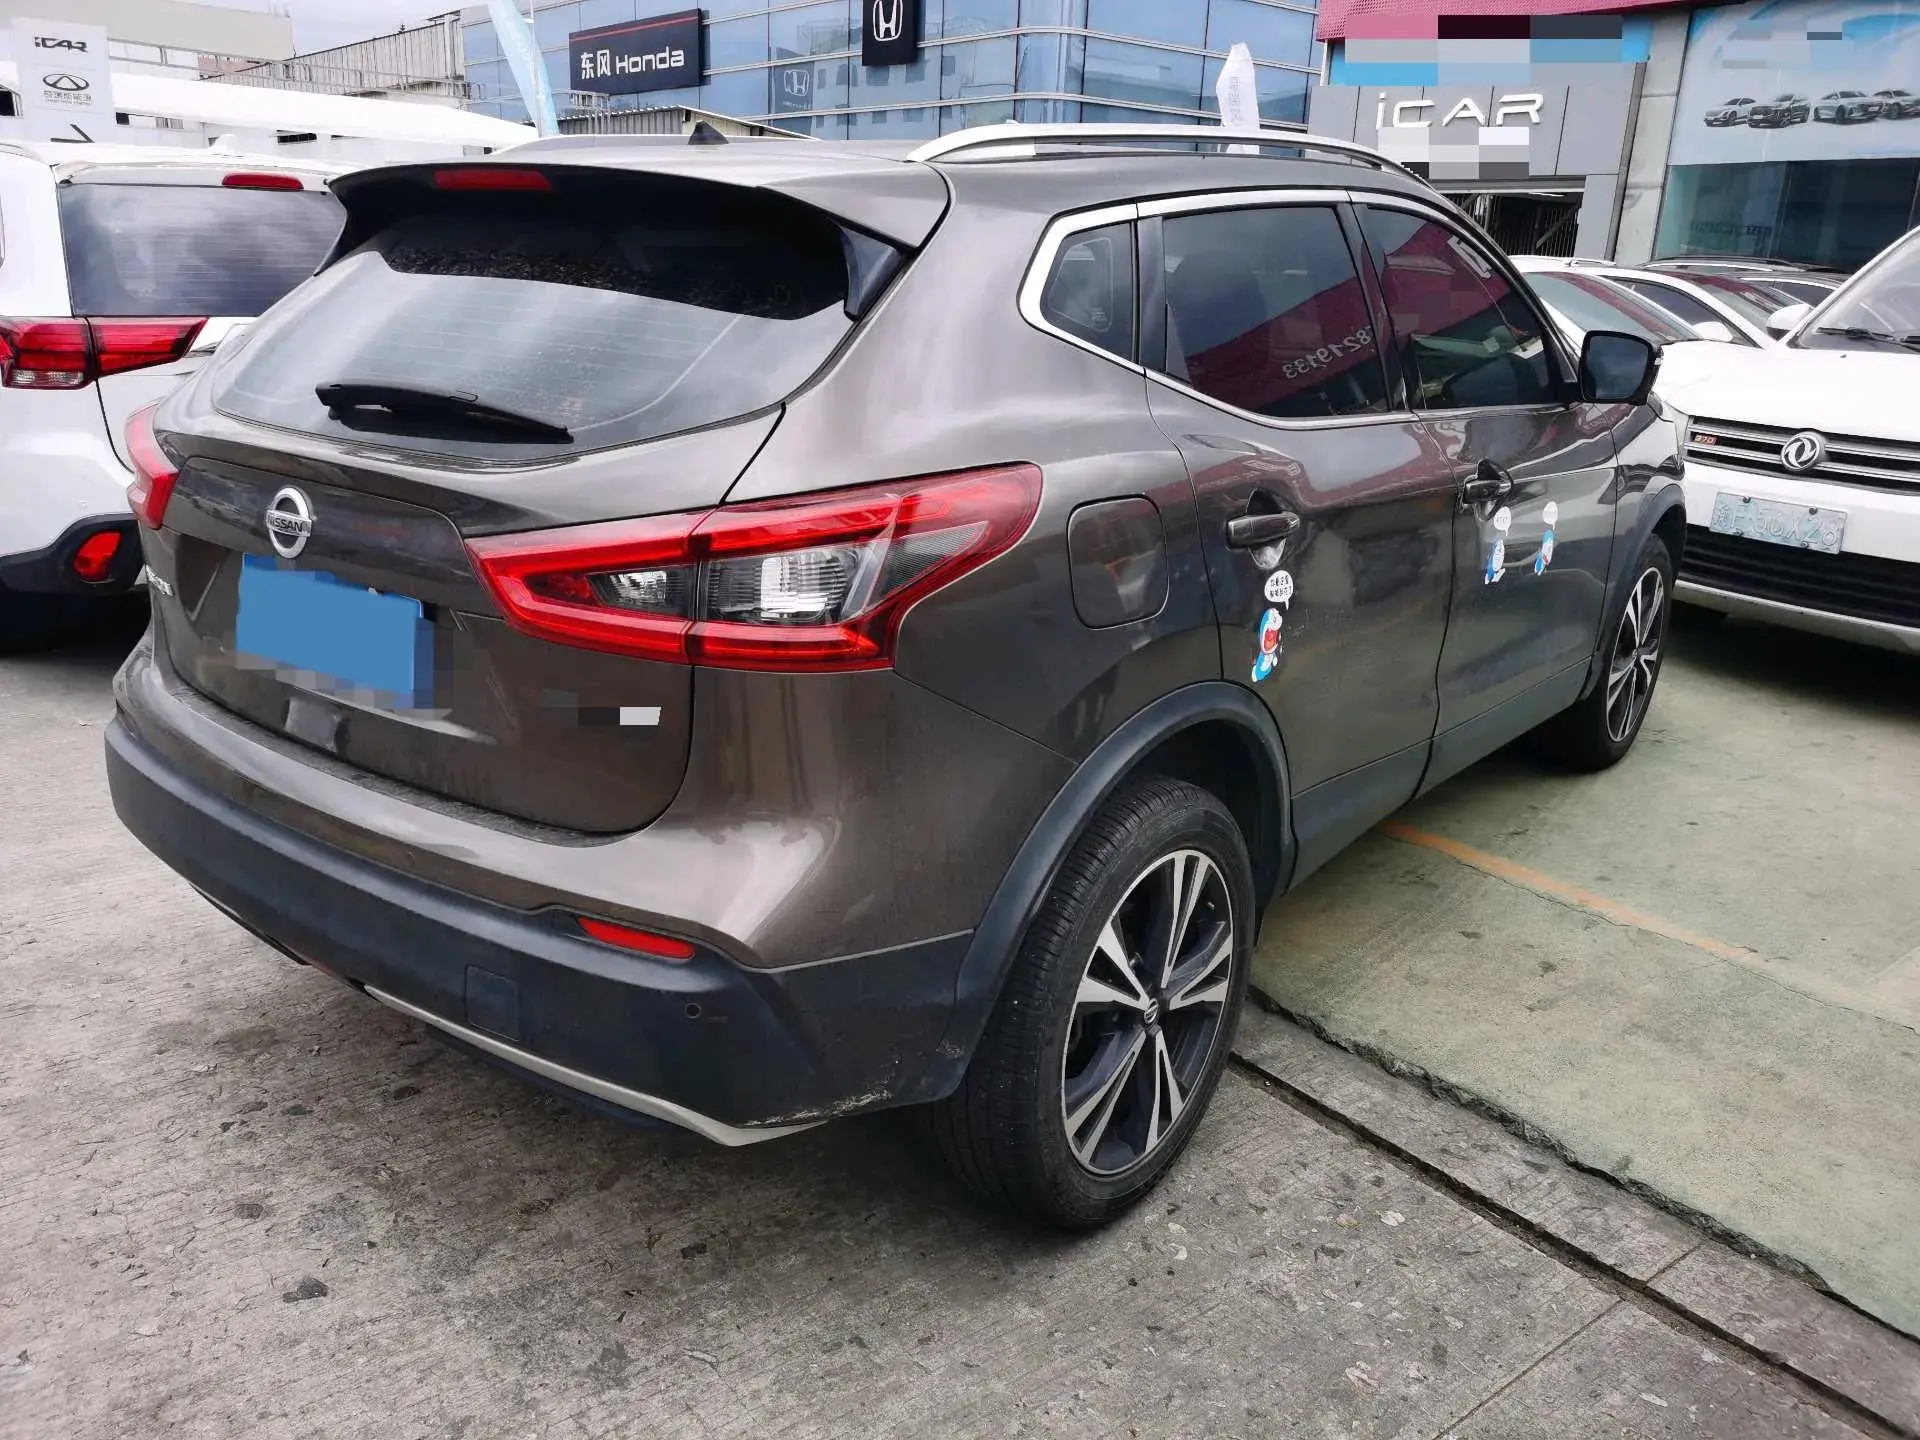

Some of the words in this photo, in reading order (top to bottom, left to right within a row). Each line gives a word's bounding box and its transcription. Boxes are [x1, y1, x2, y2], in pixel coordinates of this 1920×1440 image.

[580, 49, 611, 79] 东风
[615, 46, 685, 75] Honda
[267, 513, 304, 532] NISSAN
